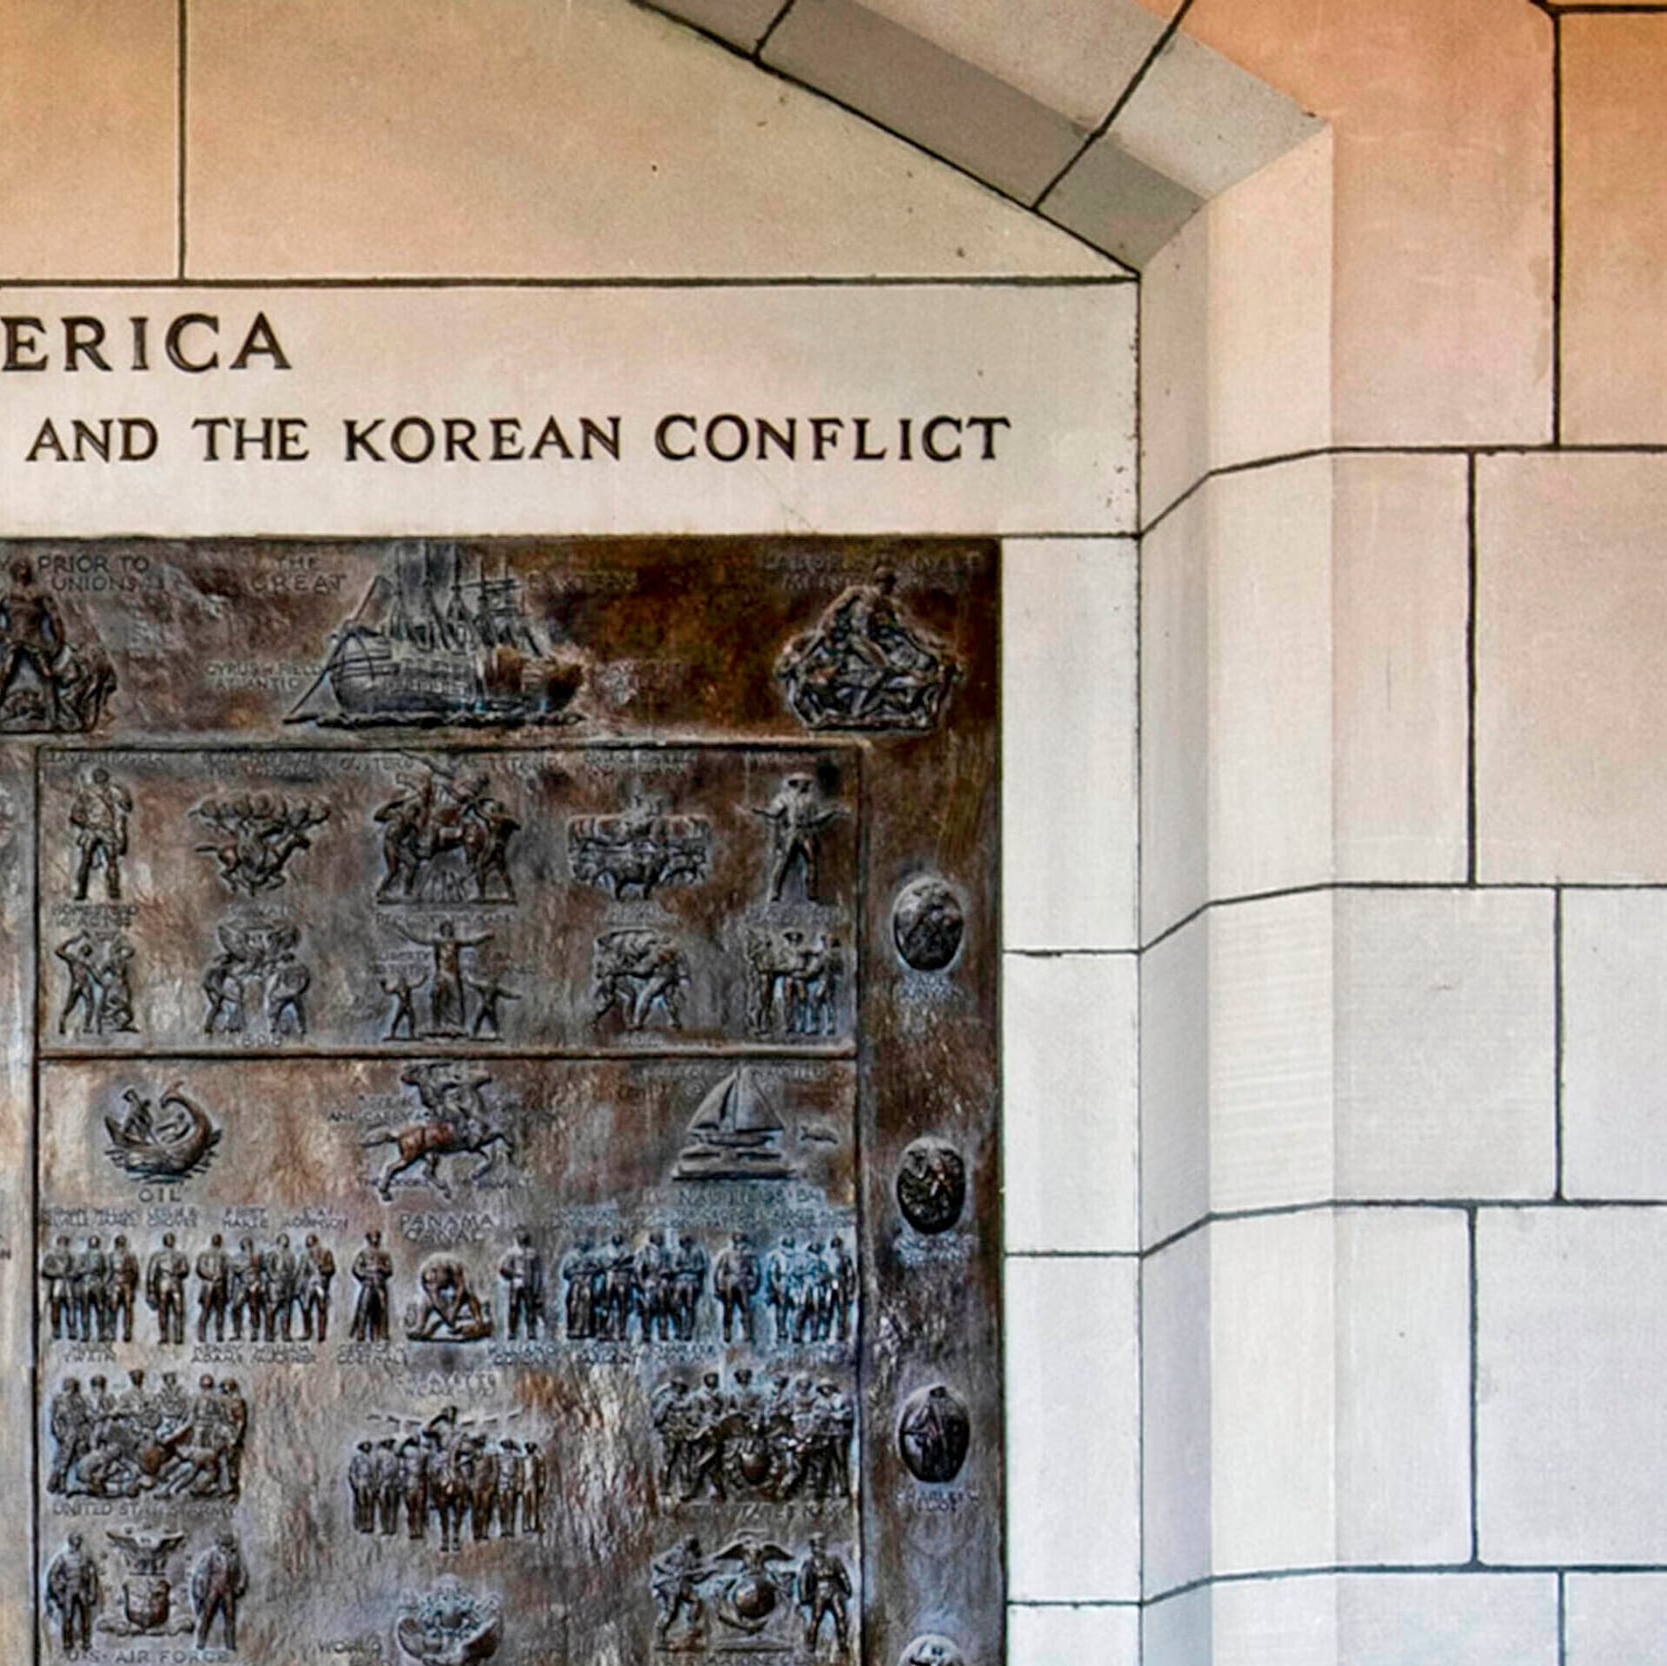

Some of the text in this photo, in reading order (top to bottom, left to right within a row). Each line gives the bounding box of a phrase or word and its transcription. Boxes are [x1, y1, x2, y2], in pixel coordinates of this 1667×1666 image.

[24, 417, 159, 464] AND
[191, 416, 310, 462] THE
[342, 414, 622, 464] KOREAN
[654, 414, 1012, 463] CONFLICT
[38, 555, 109, 574] PRIOR
[119, 555, 150, 574] TO
[51, 575, 138, 594] UNIONS
[253, 574, 347, 592] GREAT
[138, 1186, 183, 1204] OIL
[400, 1213, 493, 1229] PANAMA
[114, 1649, 151, 1665] AIR
